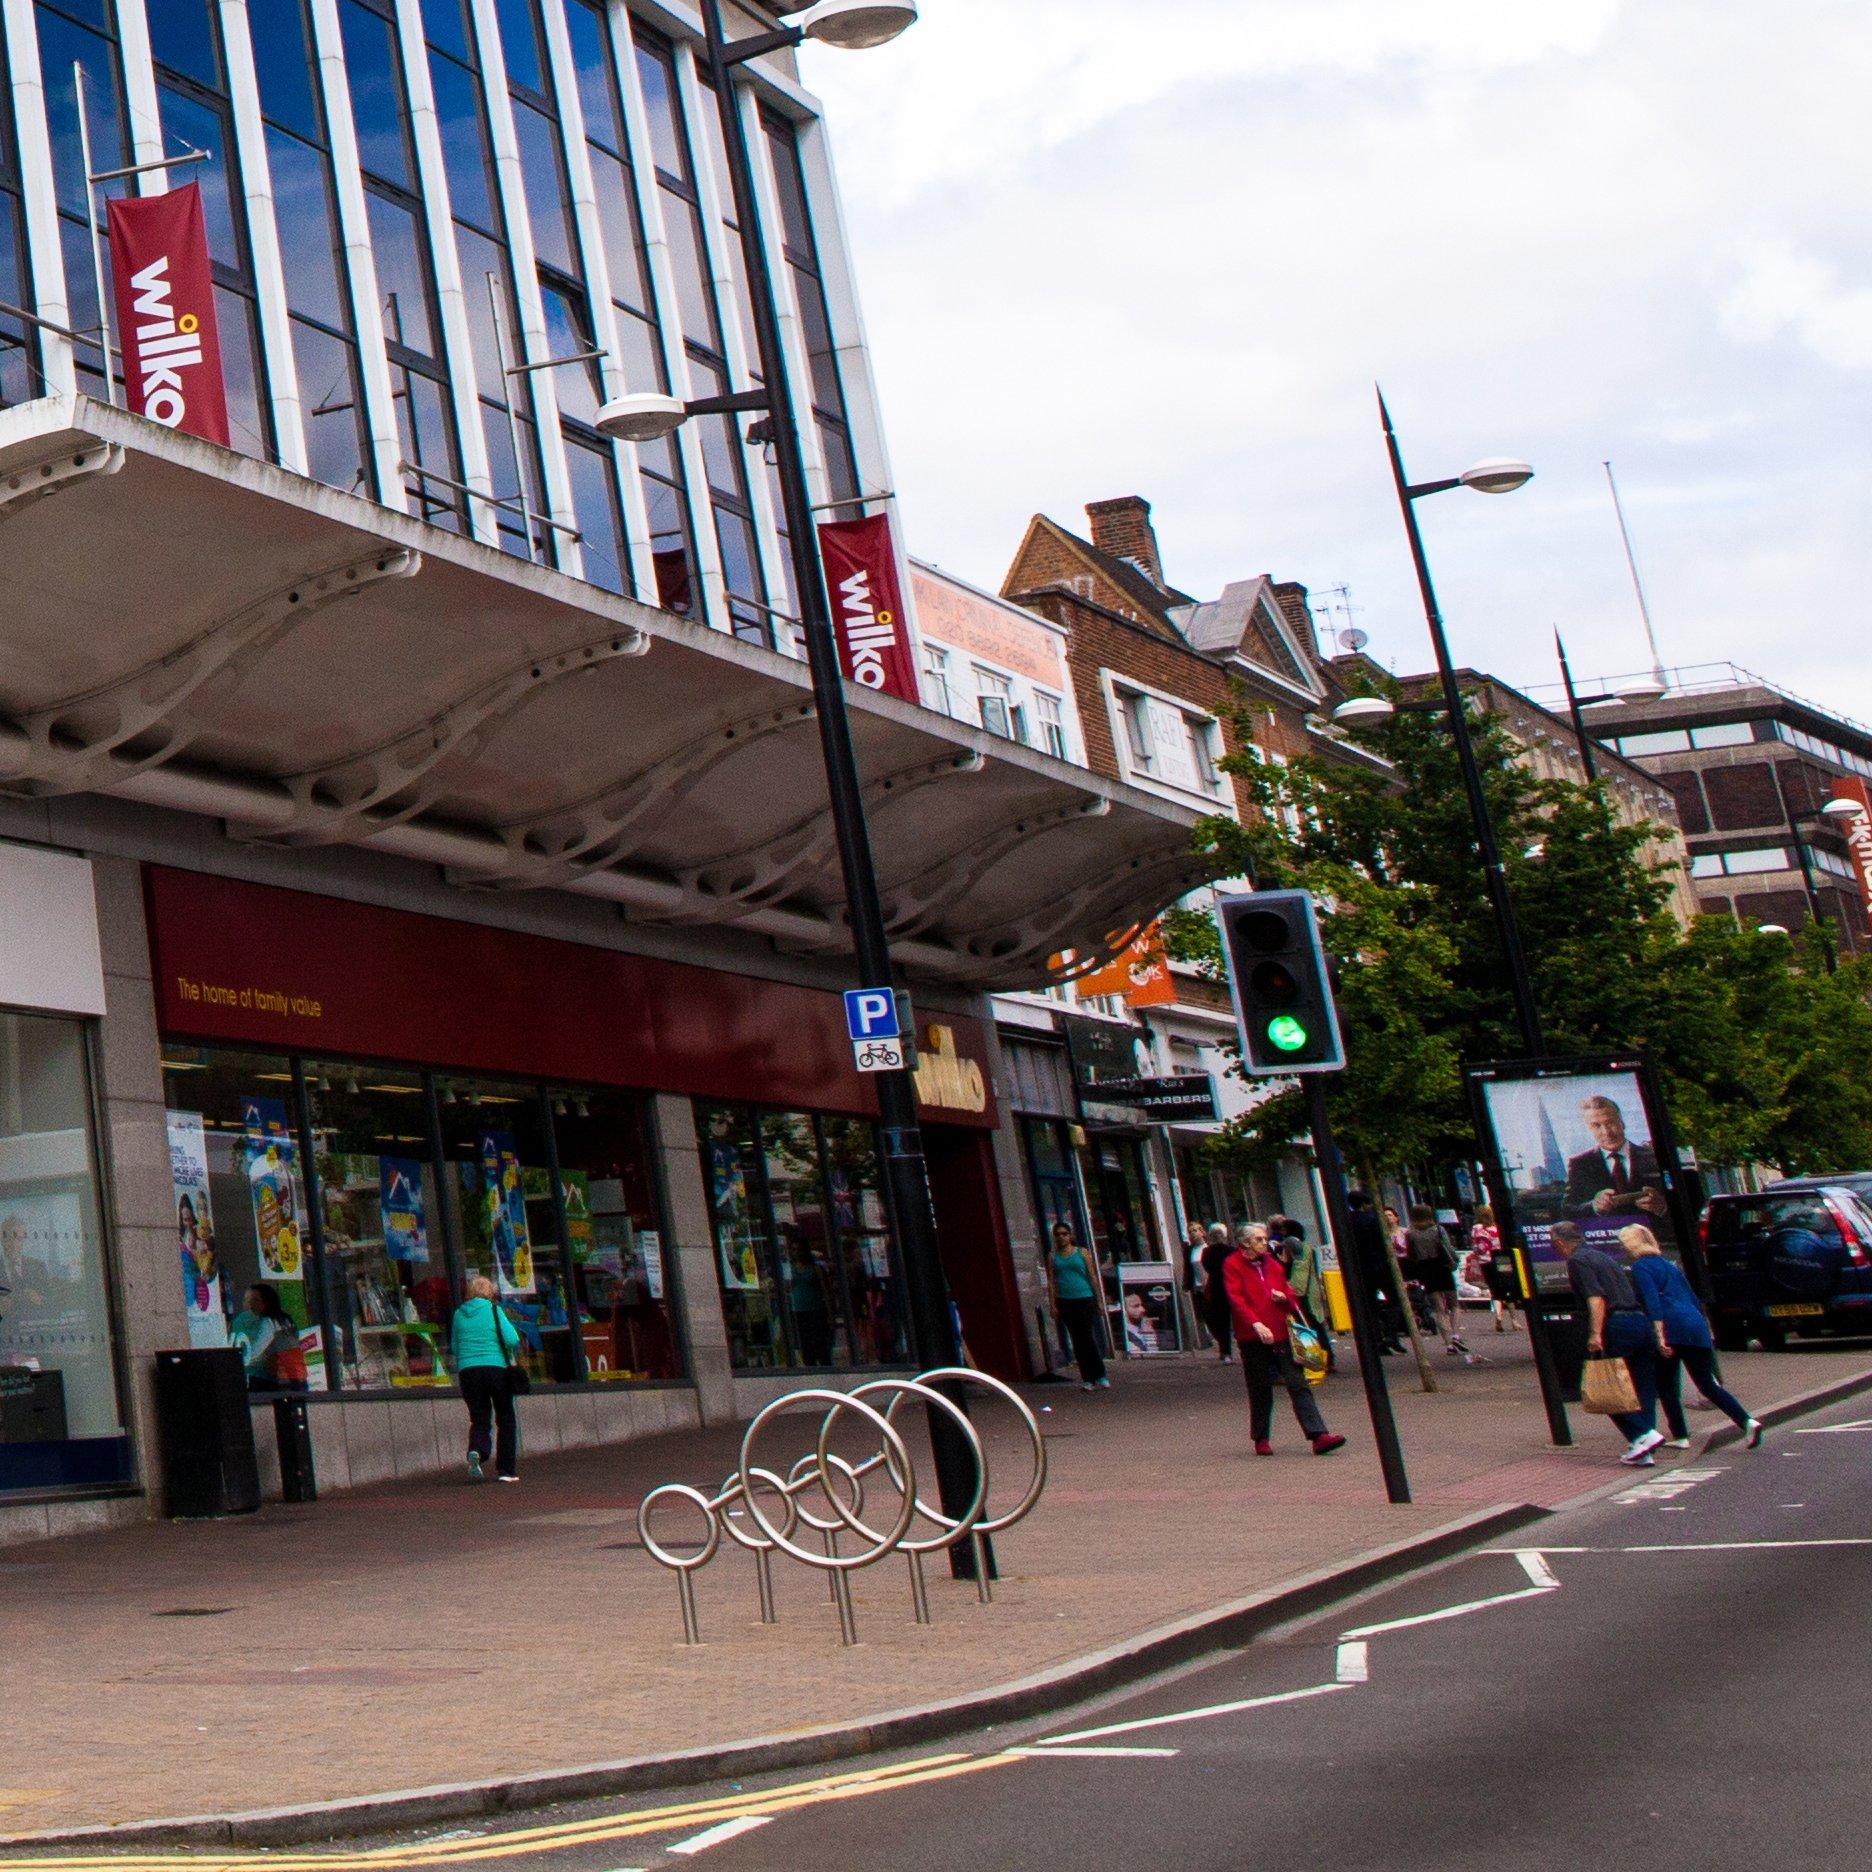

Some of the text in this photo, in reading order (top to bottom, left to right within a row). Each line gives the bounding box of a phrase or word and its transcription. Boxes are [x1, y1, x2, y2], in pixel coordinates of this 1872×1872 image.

[131, 256, 203, 428] wilko
[839, 569, 896, 690] wilko
[178, 977, 322, 1017] The home of family value
[857, 994, 888, 1034] P
